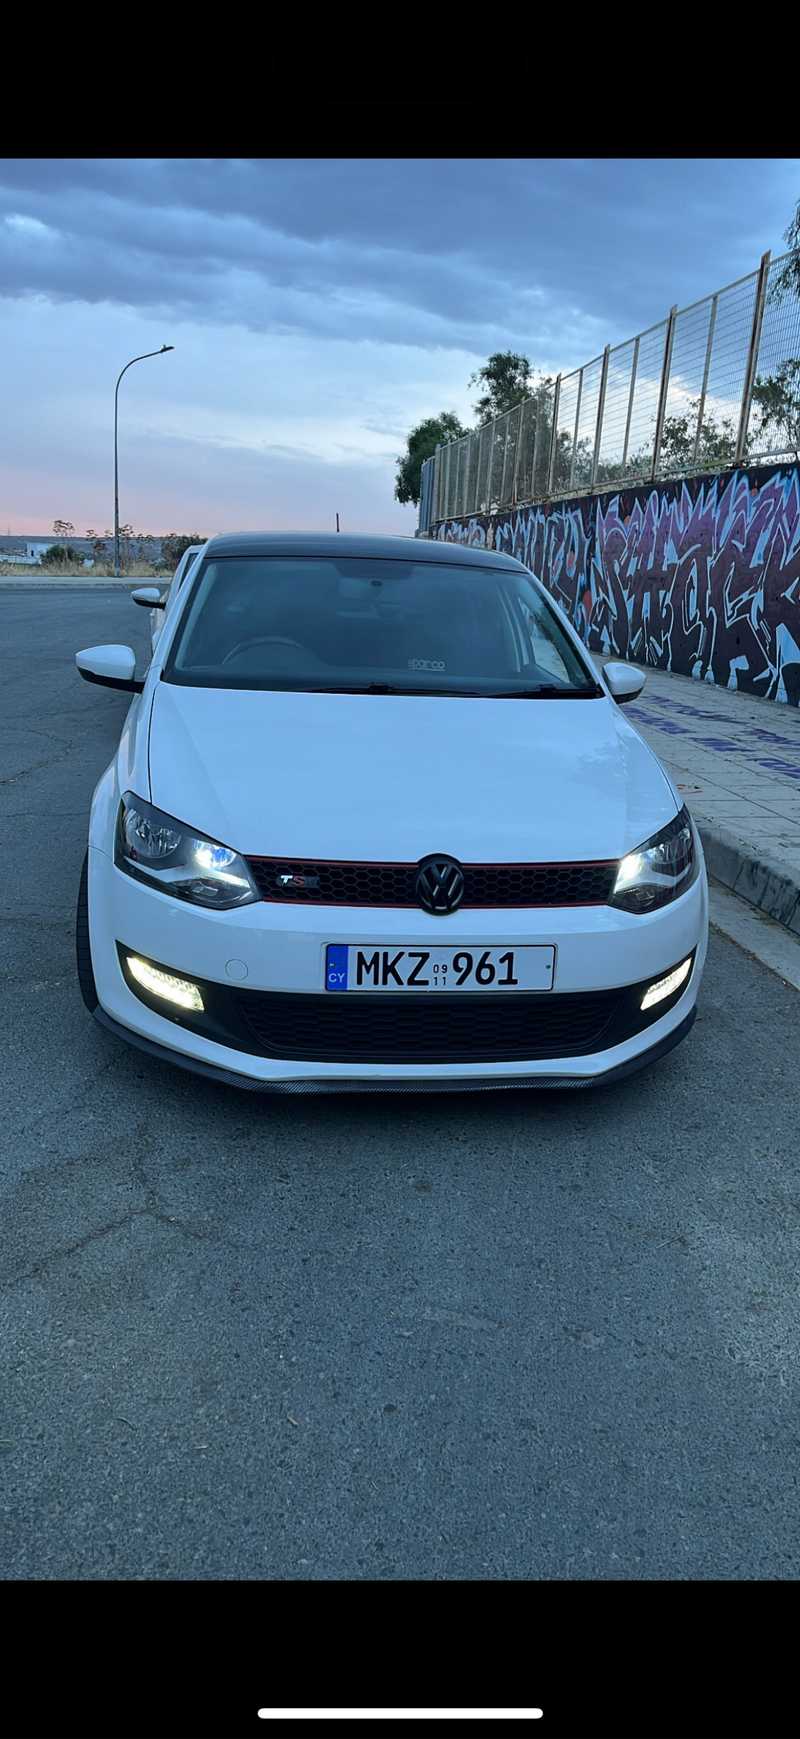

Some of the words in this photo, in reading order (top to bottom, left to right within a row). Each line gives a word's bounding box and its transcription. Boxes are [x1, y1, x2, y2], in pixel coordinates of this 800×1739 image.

[356, 951, 430, 986] MKZ
[452, 951, 519, 986] 961
[433, 964, 448, 974] 09
[328, 973, 345, 983] CY
[433, 976, 447, 986] 11
